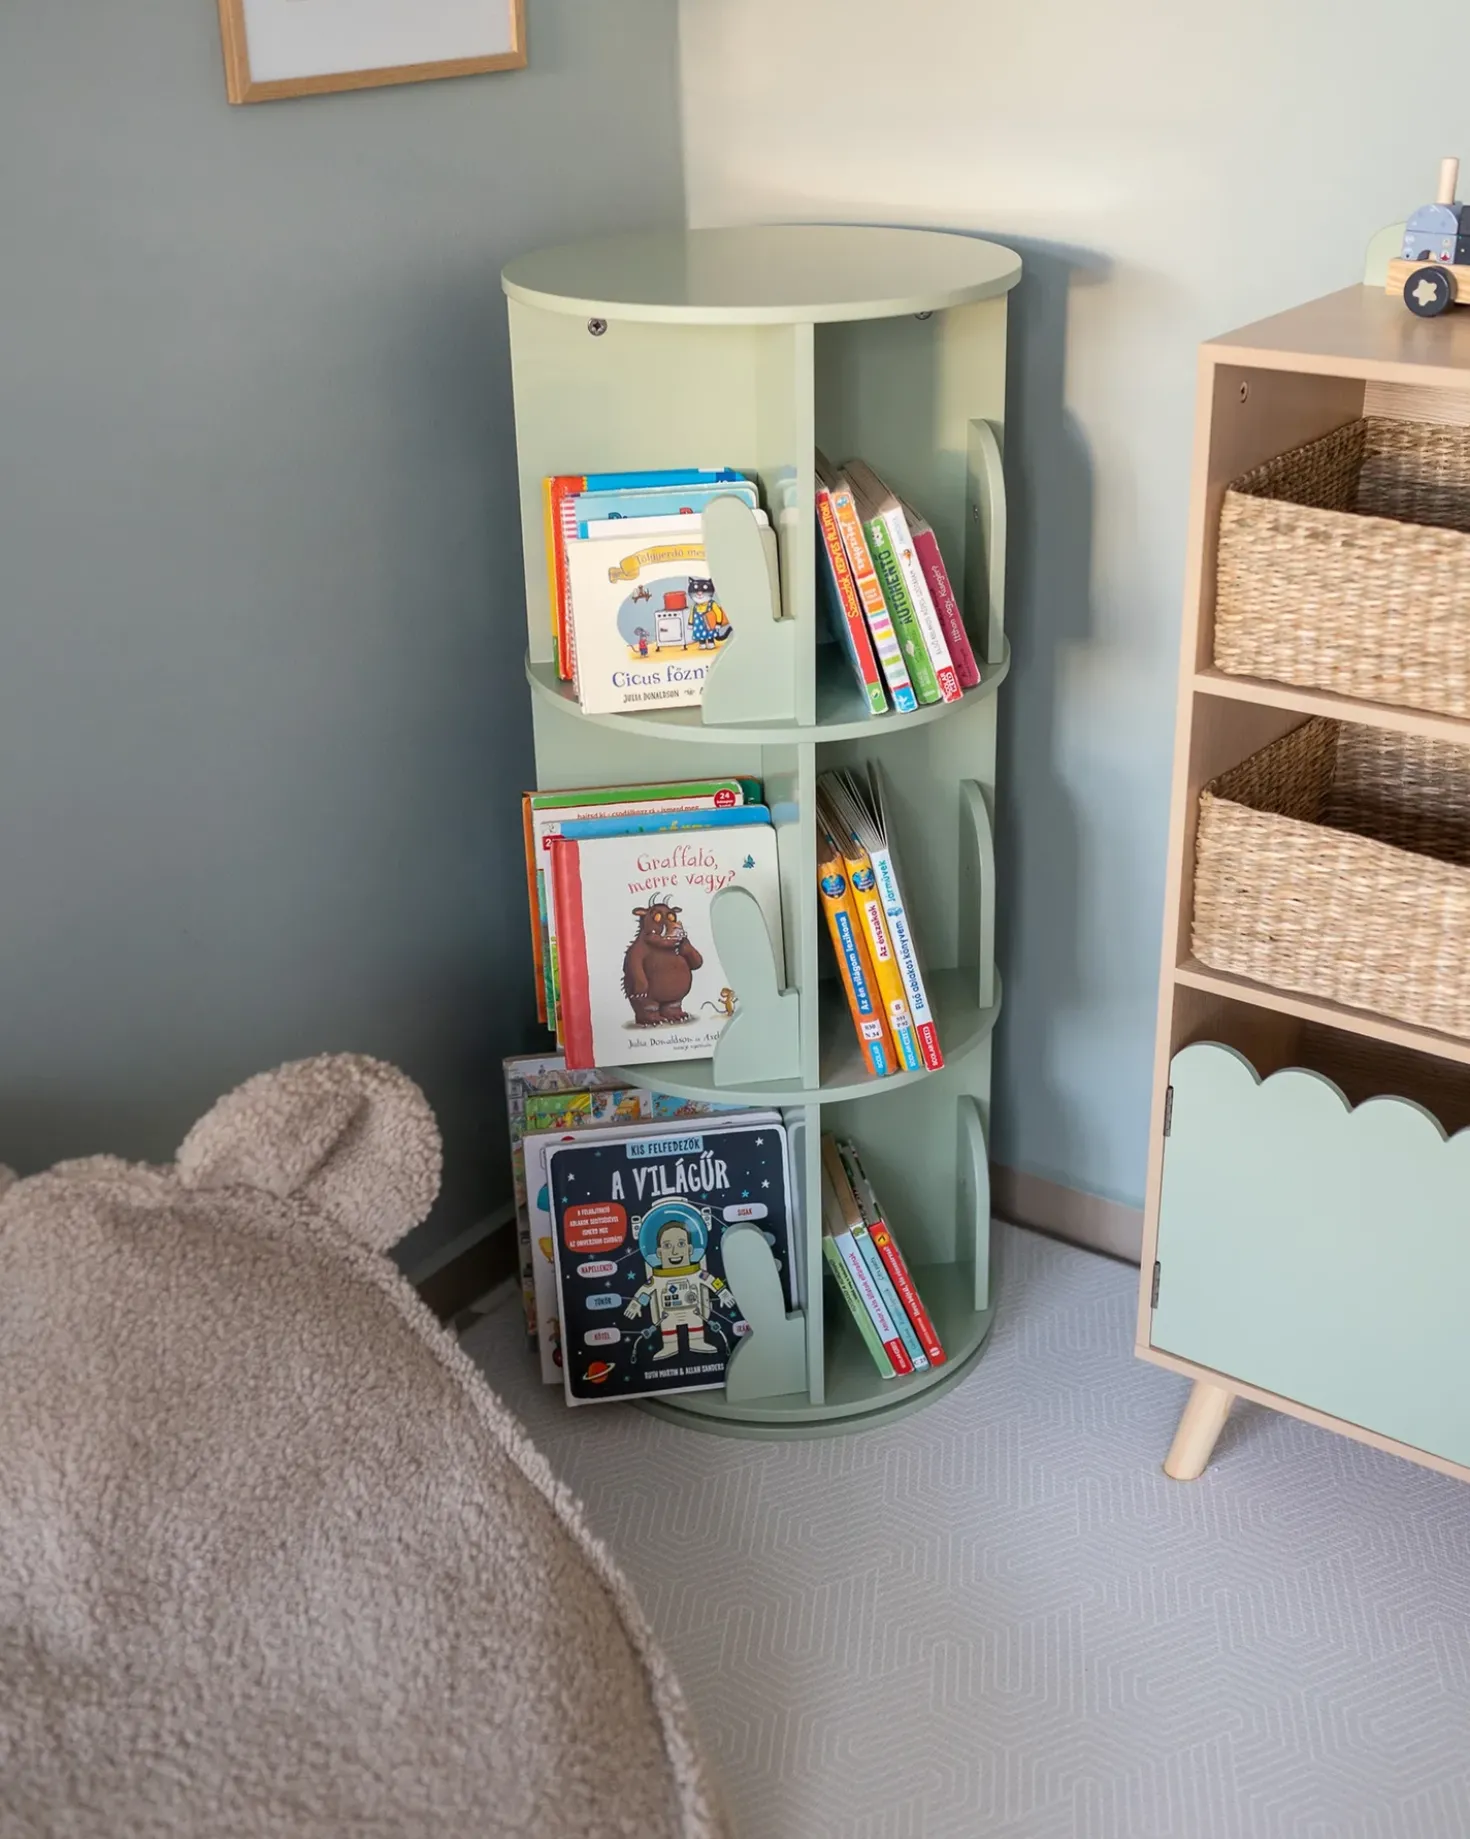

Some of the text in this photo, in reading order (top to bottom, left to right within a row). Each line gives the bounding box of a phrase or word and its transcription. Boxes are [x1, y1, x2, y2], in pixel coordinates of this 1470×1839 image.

[951, 619, 963, 642] Itthon
[612, 671, 661, 688] Cicus
[946, 672, 957, 693] KID
[623, 690, 679, 703] JULIA DONALDSON
[637, 844, 718, 872] Graffaló,
[627, 870, 736, 894] merre vagy?
[868, 904, 885, 943] évszakok
[877, 860, 924, 1010] Első ablakos könyvem Járművek
[879, 946, 889, 957] Az
[839, 916, 870, 1011] Az én világom lexikona
[628, 1038, 647, 1049] Julia
[650, 1034, 693, 1047] Donaldson
[927, 1043, 939, 1066] SCOLAR
[630, 1137, 701, 1156] KIS FELFEDEZŐK
[611, 1150, 731, 1201] A VILÁGŰR
[737, 1207, 753, 1216] SISAK
[679, 1367, 685, 1376] &
